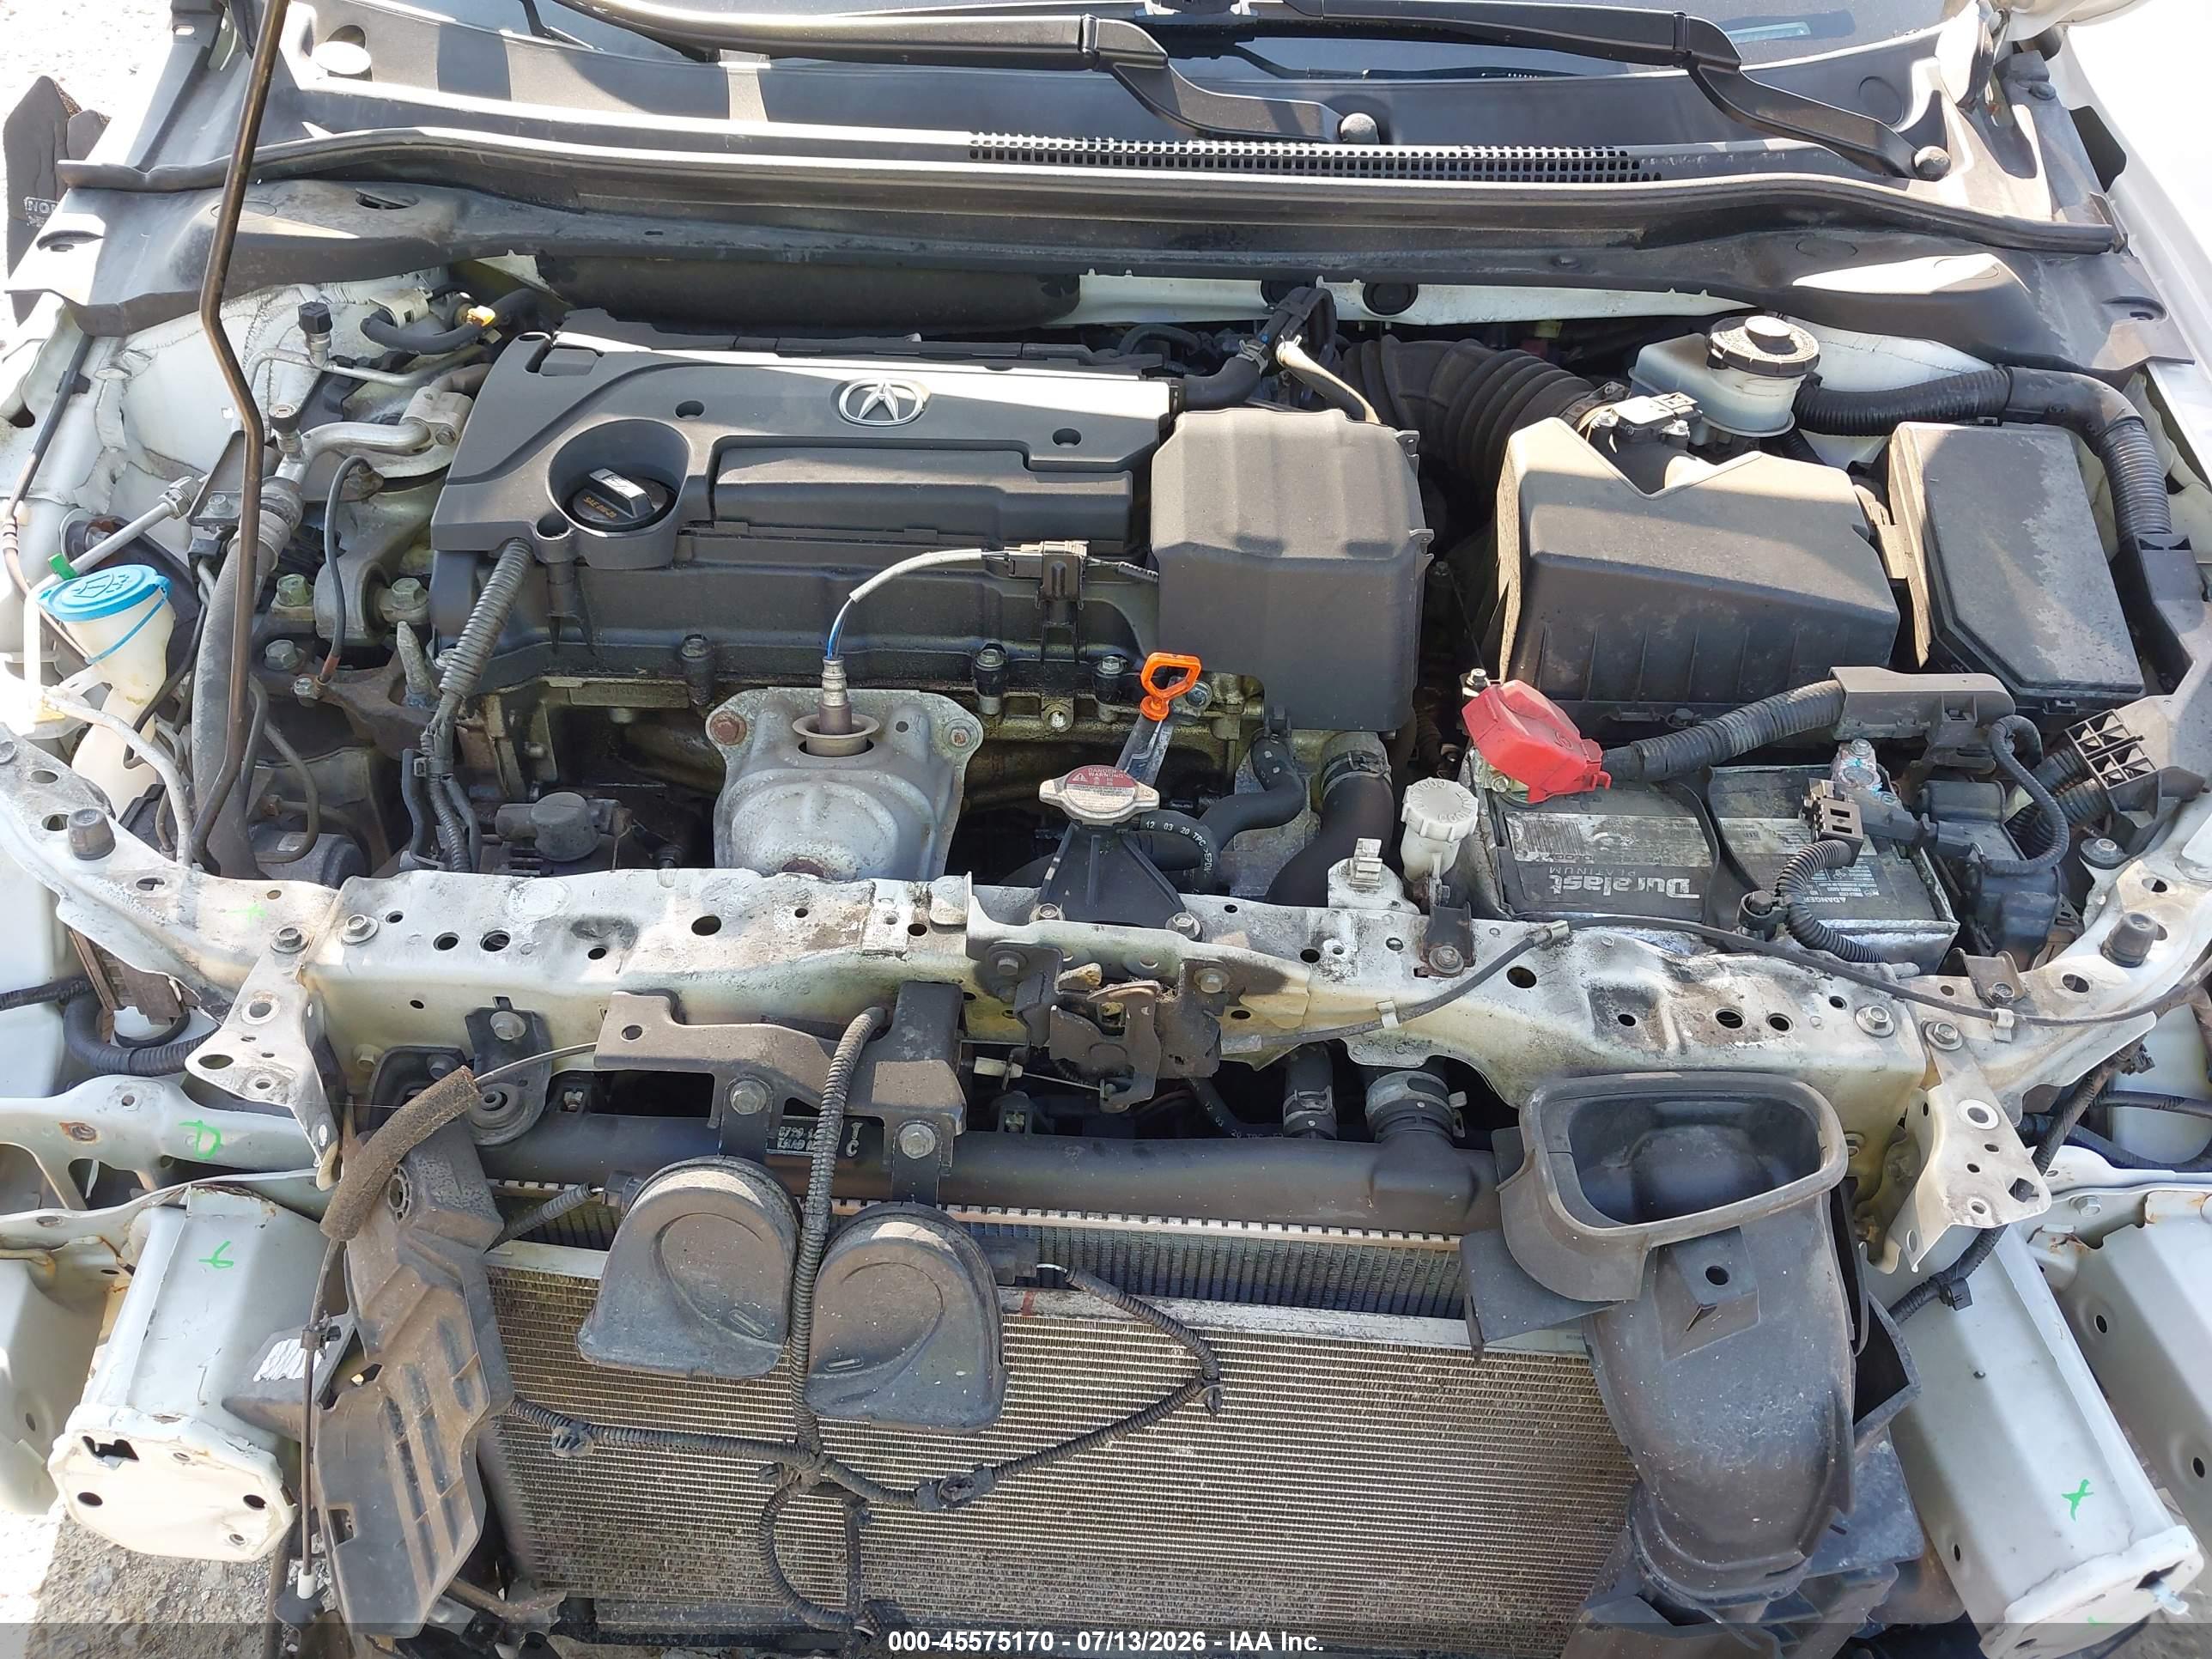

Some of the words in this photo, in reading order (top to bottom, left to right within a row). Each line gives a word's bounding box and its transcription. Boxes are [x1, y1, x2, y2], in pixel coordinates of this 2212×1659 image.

[1146, 820, 1155, 830] 12
[1164, 823, 1174, 831] 03
[1180, 826, 1190, 836] 20
[1192, 832, 1206, 847] TPC
[1549, 866, 1636, 877] PLATINUM
[1548, 874, 1701, 900] Duralast
